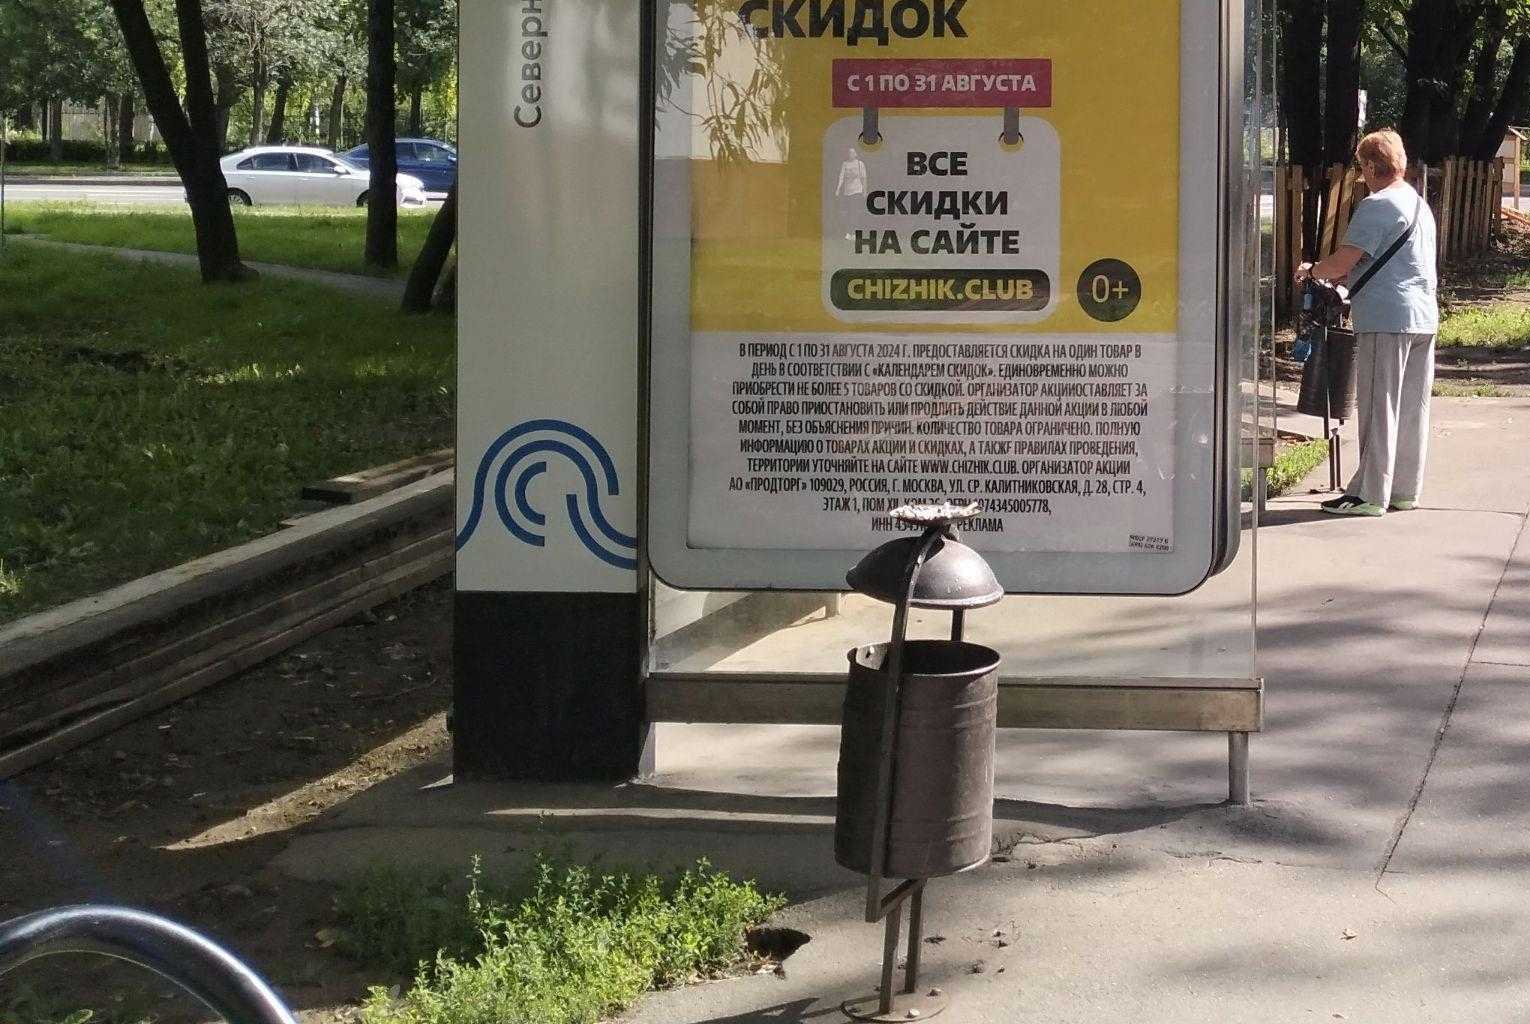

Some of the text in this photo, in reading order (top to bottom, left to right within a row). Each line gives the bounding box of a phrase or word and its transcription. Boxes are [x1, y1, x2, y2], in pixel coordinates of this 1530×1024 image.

[847, 75, 1036, 92] С 1 ПО 31 АВГУСТА
[906, 152, 968, 176] ВСЕ
[866, 191, 1008, 219] СКИДКИ
[854, 223, 1020, 254] НА САЙТЕ
[847, 278, 1033, 300] CHIZHIK.CLUB
[1091, 275, 1129, 303] 0+
[739, 343, 1142, 361] В ПЕРИОД С 1 ПО 31 АВГУСТА 2024 Г. ПРЕДОСТАВЛЯЕТСЯ СКИДКА НА ОДИН ТОВАР В
[752, 362, 777, 380] ДЕНЬ
[778, 362, 786, 377] В
[787, 362, 863, 377] СООТВЕТСТВИИ
[864, 362, 871, 377] С
[997, 362, 1087, 380] ЕДИНОВРЕМЕННО
[1088, 362, 1130, 377] МОЖНО
[732, 382, 795, 397] ПРИОБРЕСТИ
[796, 382, 809, 397] НЕ
[810, 382, 842, 397] БОЛЕЕ
[843, 382, 850, 397] 5
[851, 382, 897, 397] ТОВАРОВ
[898, 382, 913, 397] СО
[914, 380, 965, 400] СКИДКОЙ.
[966, 382, 1039, 397] ОРГАНИЗАТОР
[1134, 382, 1149, 397] ЗА
[732, 399, 1149, 419] СОБОЙ ПРАВО ПРИОСТАНОВИТЬ ИЛИ ПРОДЛИТЬ ДЕЙСТВИЕ ДАННОЙ АКЦИИ В ЛЮБОЙ
[739, 420, 1142, 438] МОМЕНТ, БЕЗ ОБЪЯСНЕНИЯ ПРИЧИН. КОЛИЧЕСТВО ТОВАРА ОГРАНИЧЕНО. ПОЛНУЮ
[741, 440, 815, 458] ИНФОРМАЦИЮ
[816, 440, 824, 455] О
[825, 440, 870, 455] ТОВАРАХ
[871, 440, 907, 458] АКЦИИ
[908, 440, 916, 455] И
[917, 440, 967, 458] СКИДКАХ,
[968, 440, 977, 455] А
[1013, 440, 1068, 455] ПРАВИЛАХ
[1069, 440, 1140, 458] ПРОВЕДЕНИЯ,
[748, 459, 811, 474] ТЕРРИТОРИИ
[812, 457, 869, 474] УТОЧНЯЙТЕ
[870, 459, 885, 474] НА
[886, 457, 919, 474] САЙТЕ
[1021, 459, 1094, 474] ОРГАНИЗАТОР
[1095, 459, 1132, 477] АКЦИИ
[729, 478, 744, 494] АО
[809, 478, 847, 497] 109029,
[848, 478, 890, 497] РОССИЯ,
[891, 478, 900, 494] Г.
[901, 478, 947, 497] МОСКВА,
[948, 478, 965, 494] УЛ.
[984, 478, 1081, 497] КАЛИТНИКОВСКАЯ,
[1095, 478, 1111, 497] 28,
[1112, 478, 1134, 494] СТР.
[1135, 478, 1147, 497] 4,
[823, 497, 850, 512] ЭТАЖ
[853, 497, 860, 515] 1,
[863, 497, 885, 512] ПОМ
[971, 497, 1052, 515] 074345005778,
[871, 517, 893, 532] ИНН
[957, 517, 1004, 532] РЕКЛАМА
